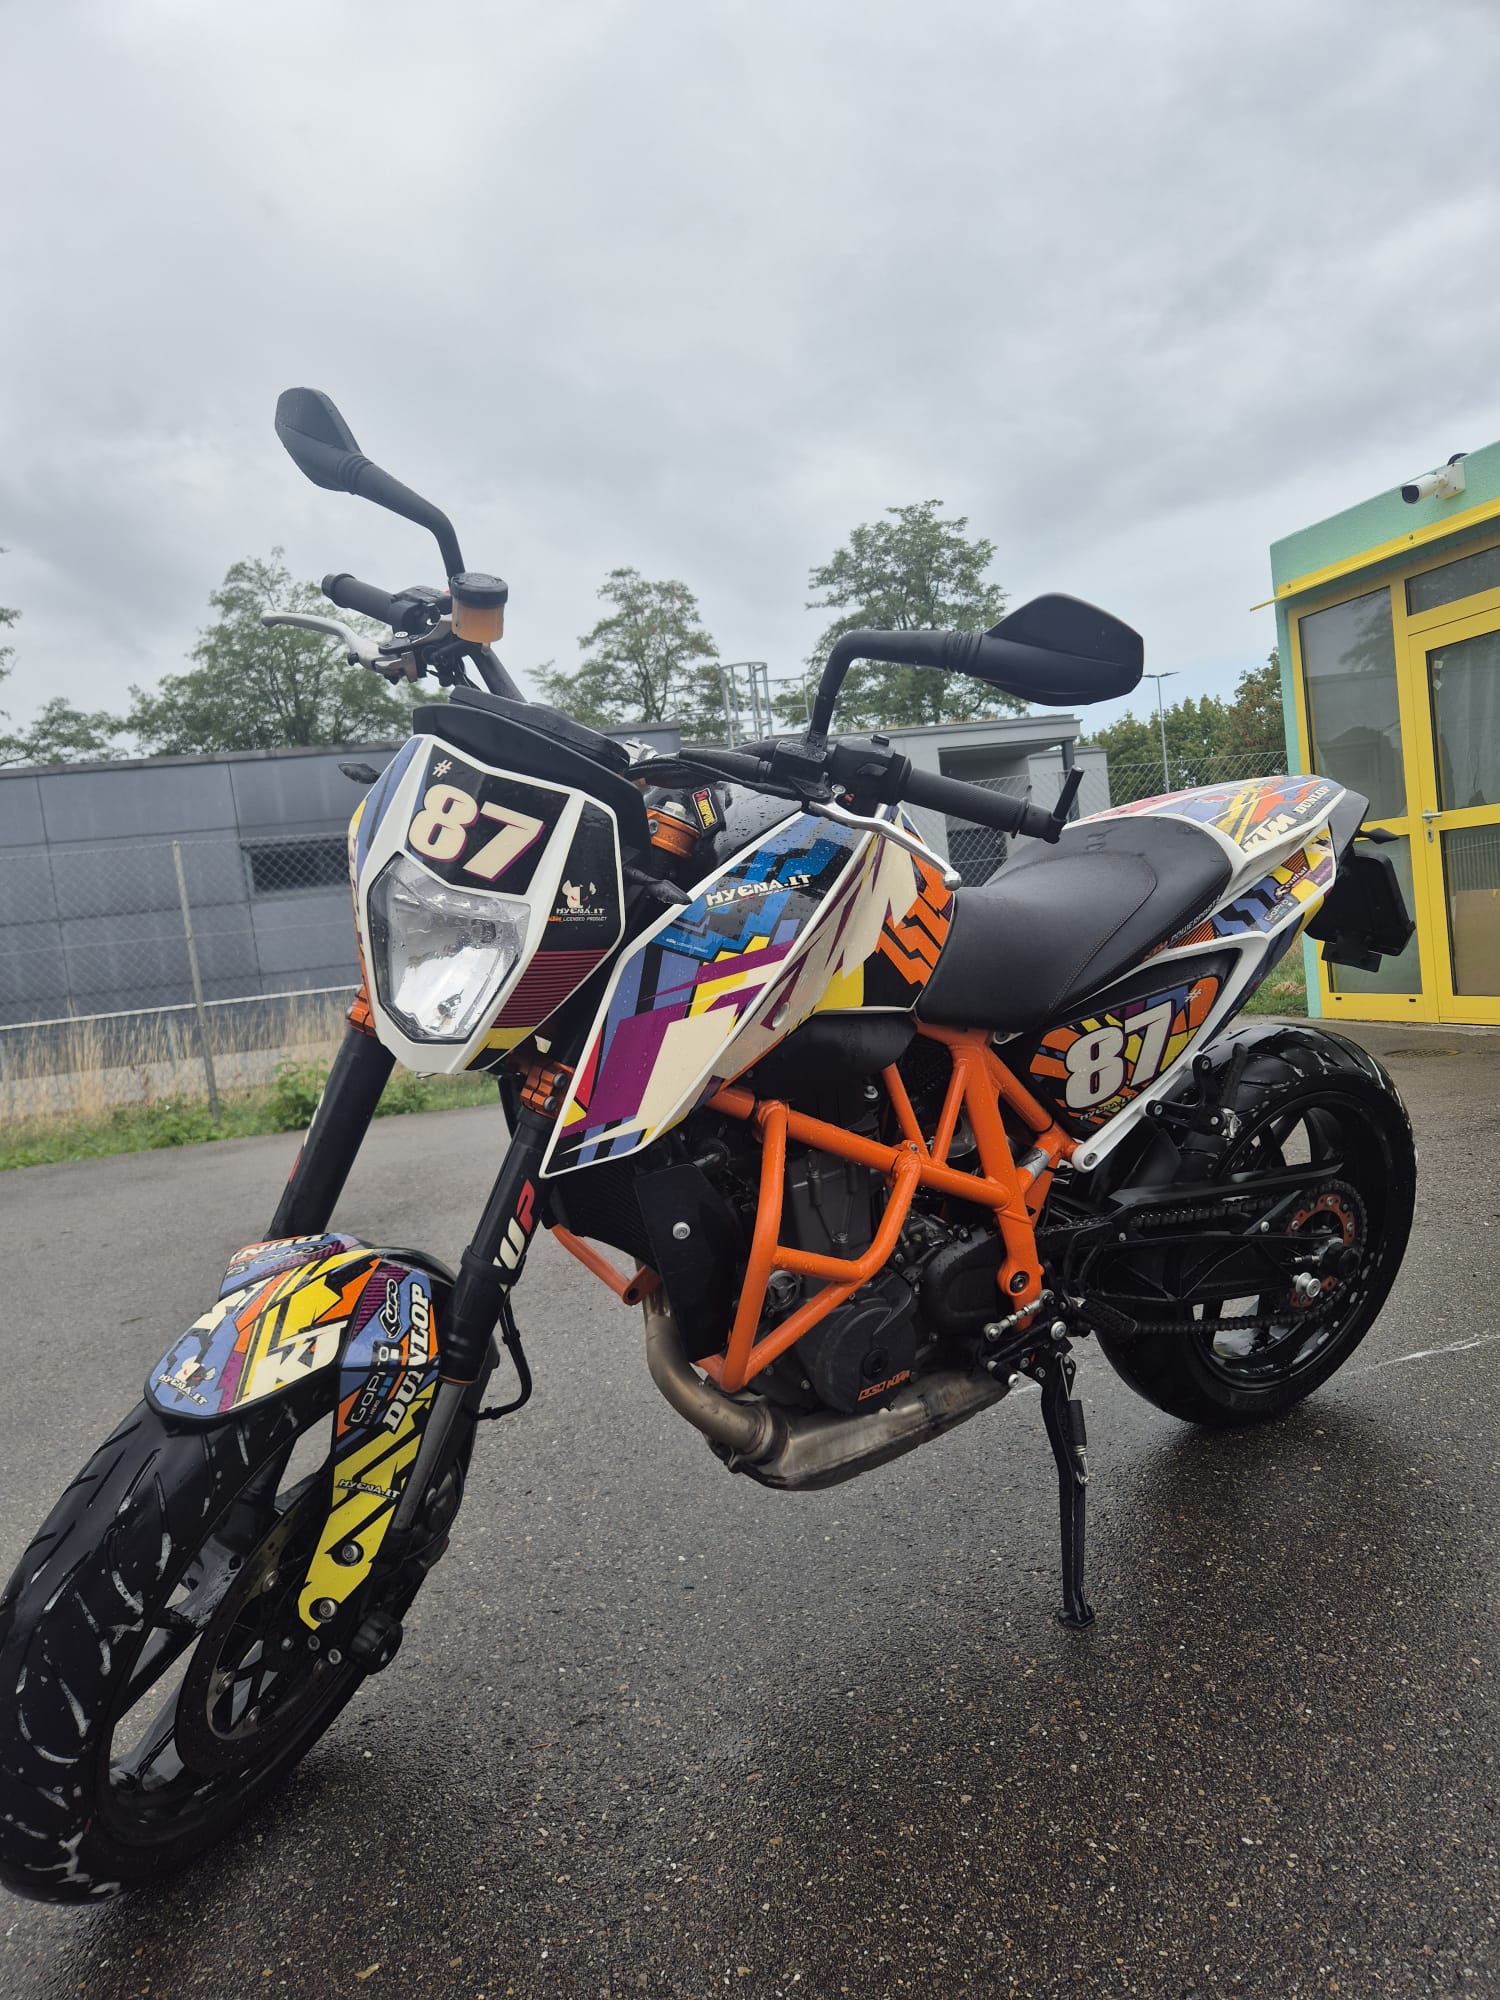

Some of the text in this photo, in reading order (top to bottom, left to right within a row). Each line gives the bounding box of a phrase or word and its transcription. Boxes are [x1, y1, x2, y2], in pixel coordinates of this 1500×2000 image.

[432, 760, 453, 778] #
[1293, 786, 1331, 815] DUNLOP
[408, 783, 544, 881] 87
[706, 875, 811, 906] HYENA.IT
[1065, 1000, 1172, 1109] 87
[339, 1479, 401, 1499] HYENA.IT
